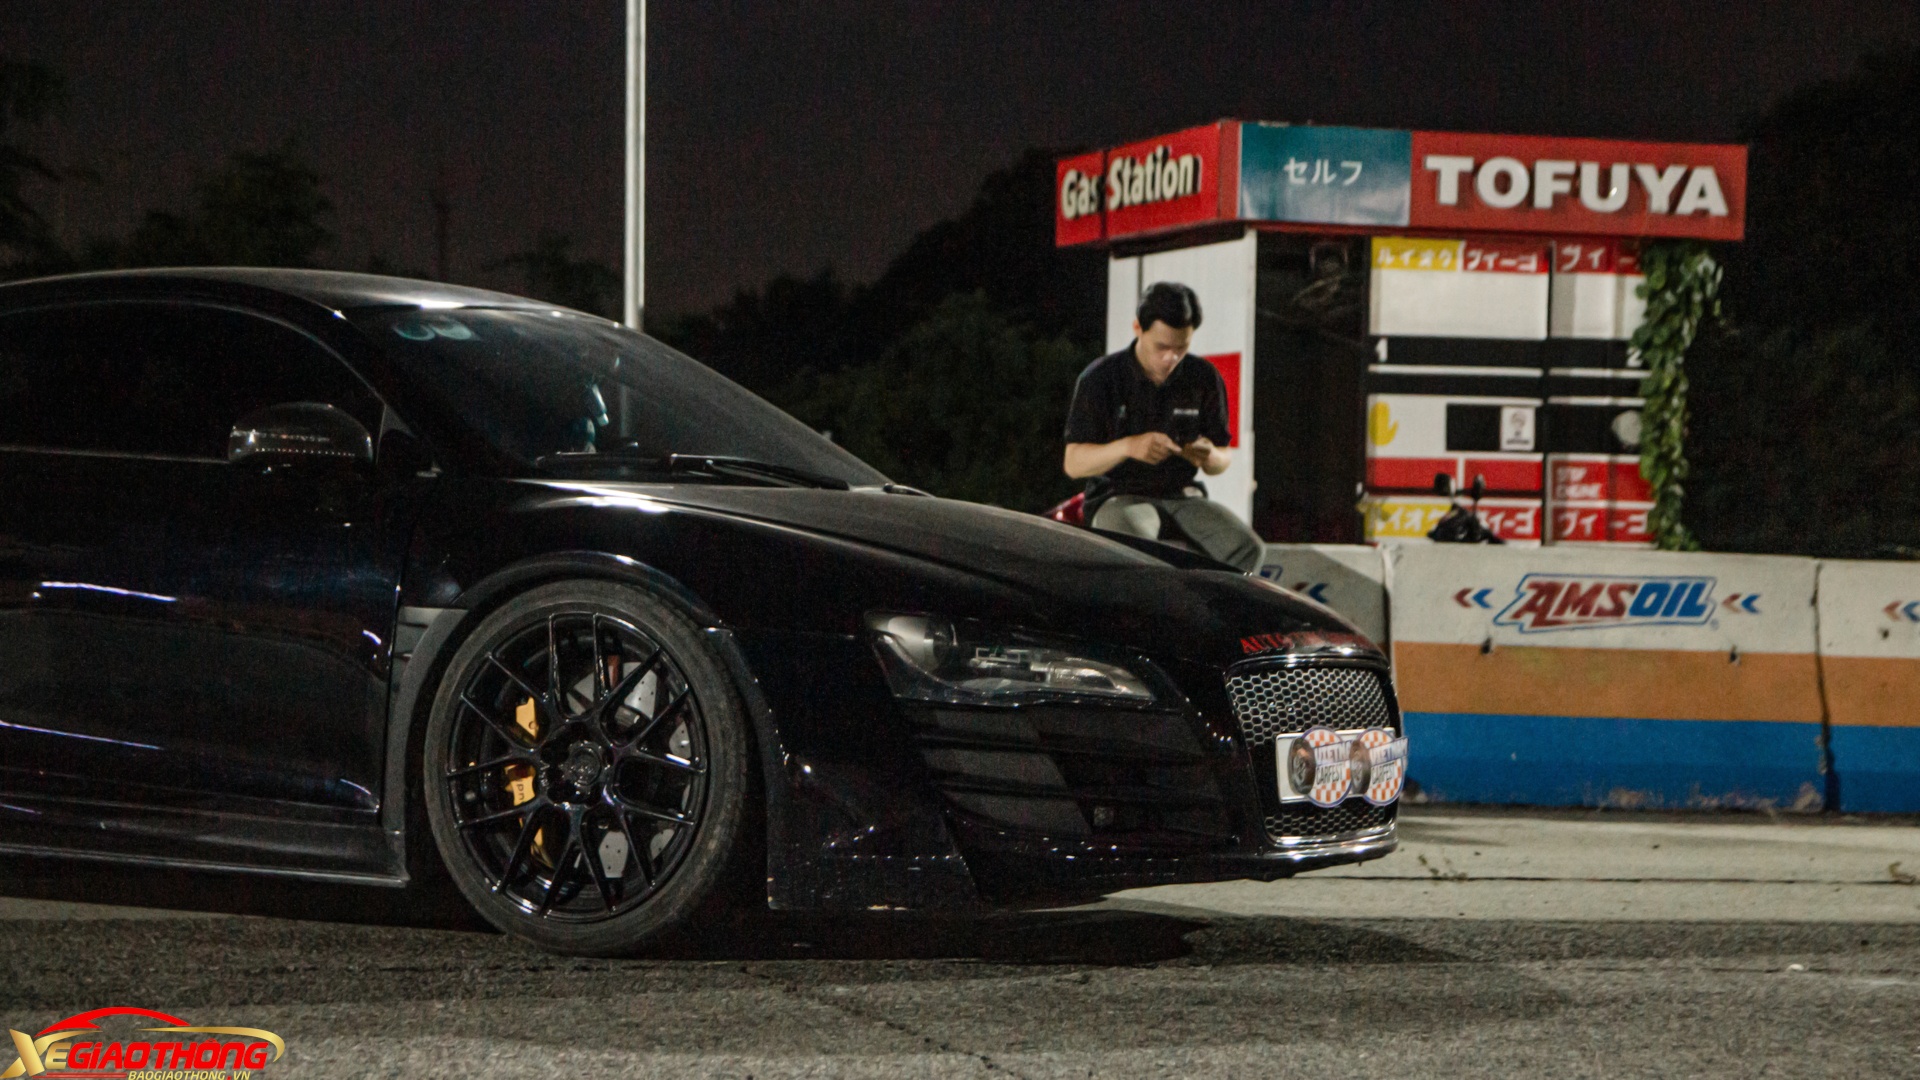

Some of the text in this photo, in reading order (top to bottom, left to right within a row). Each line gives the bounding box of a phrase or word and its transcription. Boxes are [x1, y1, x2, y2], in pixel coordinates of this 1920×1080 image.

[1061, 144, 1197, 220] Gas Station
[1284, 156, 1363, 186] セルフ
[1425, 155, 1729, 218] TOFUYA
[1375, 338, 1388, 363] 1
[1626, 347, 1643, 368] 2
[1511, 580, 1708, 628] AMSOIL
[1316, 763, 1344, 786] CARFEST
